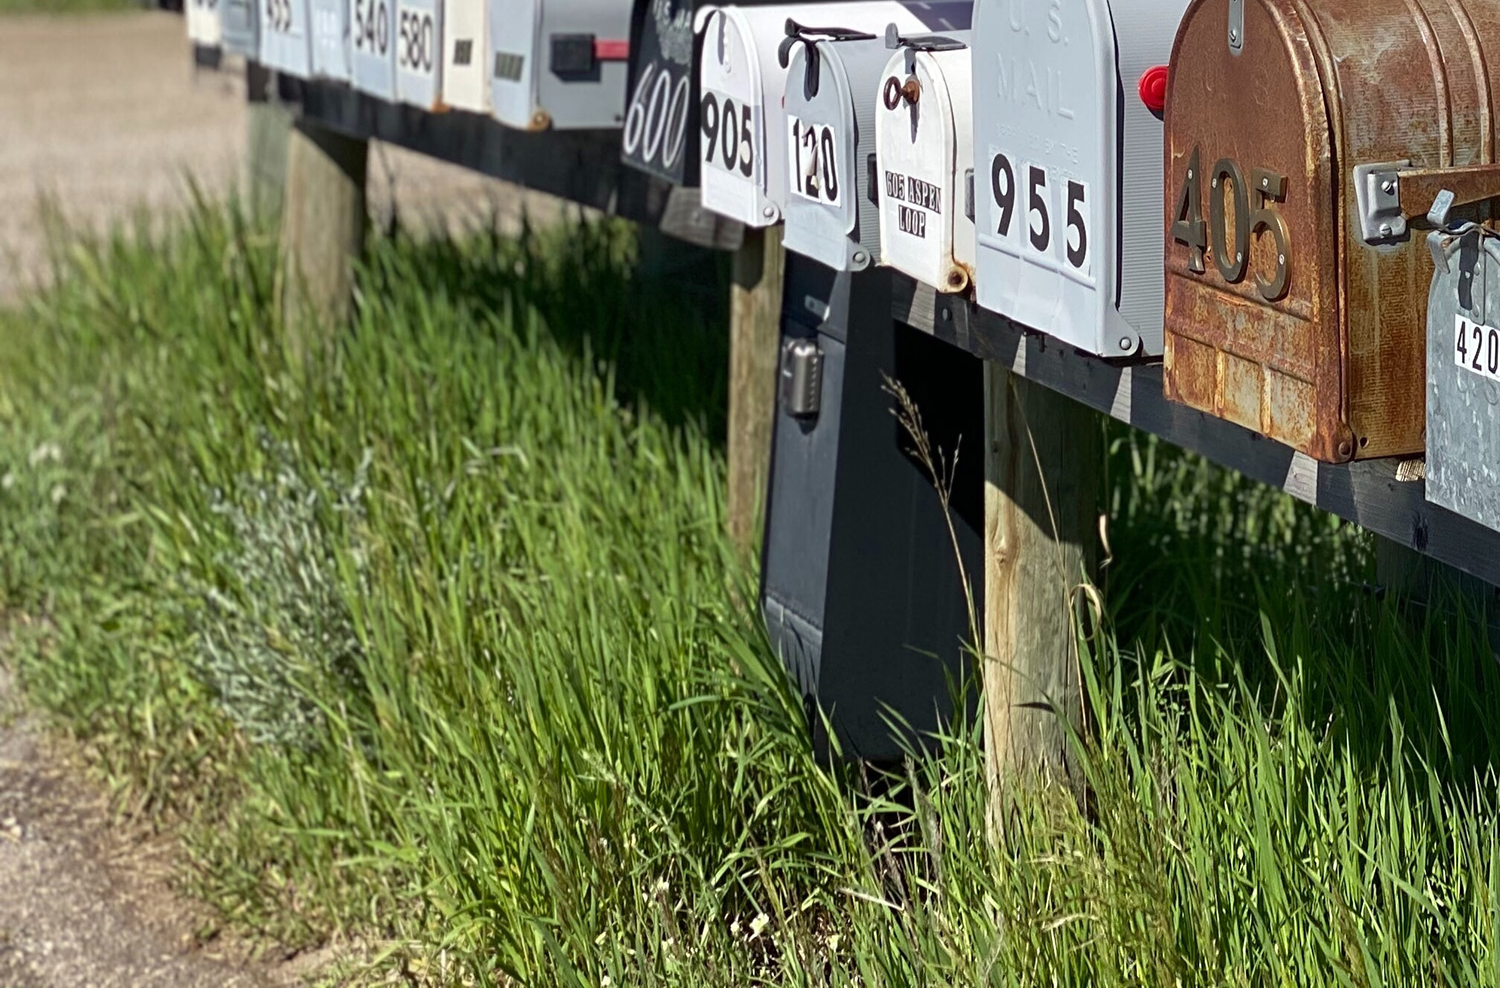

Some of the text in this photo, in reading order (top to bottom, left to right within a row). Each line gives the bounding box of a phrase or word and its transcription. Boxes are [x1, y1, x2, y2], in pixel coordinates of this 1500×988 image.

[400, 10, 433, 72] 580
[623, 63, 690, 169] 600
[701, 92, 754, 178] 905
[793, 118, 839, 202] 120
[886, 172, 942, 214] 605 ASPEN
[899, 206, 926, 237] LOOP
[991, 153, 1088, 269] 955
[1171, 145, 1292, 302] 405
[1457, 321, 1499, 374] 420
